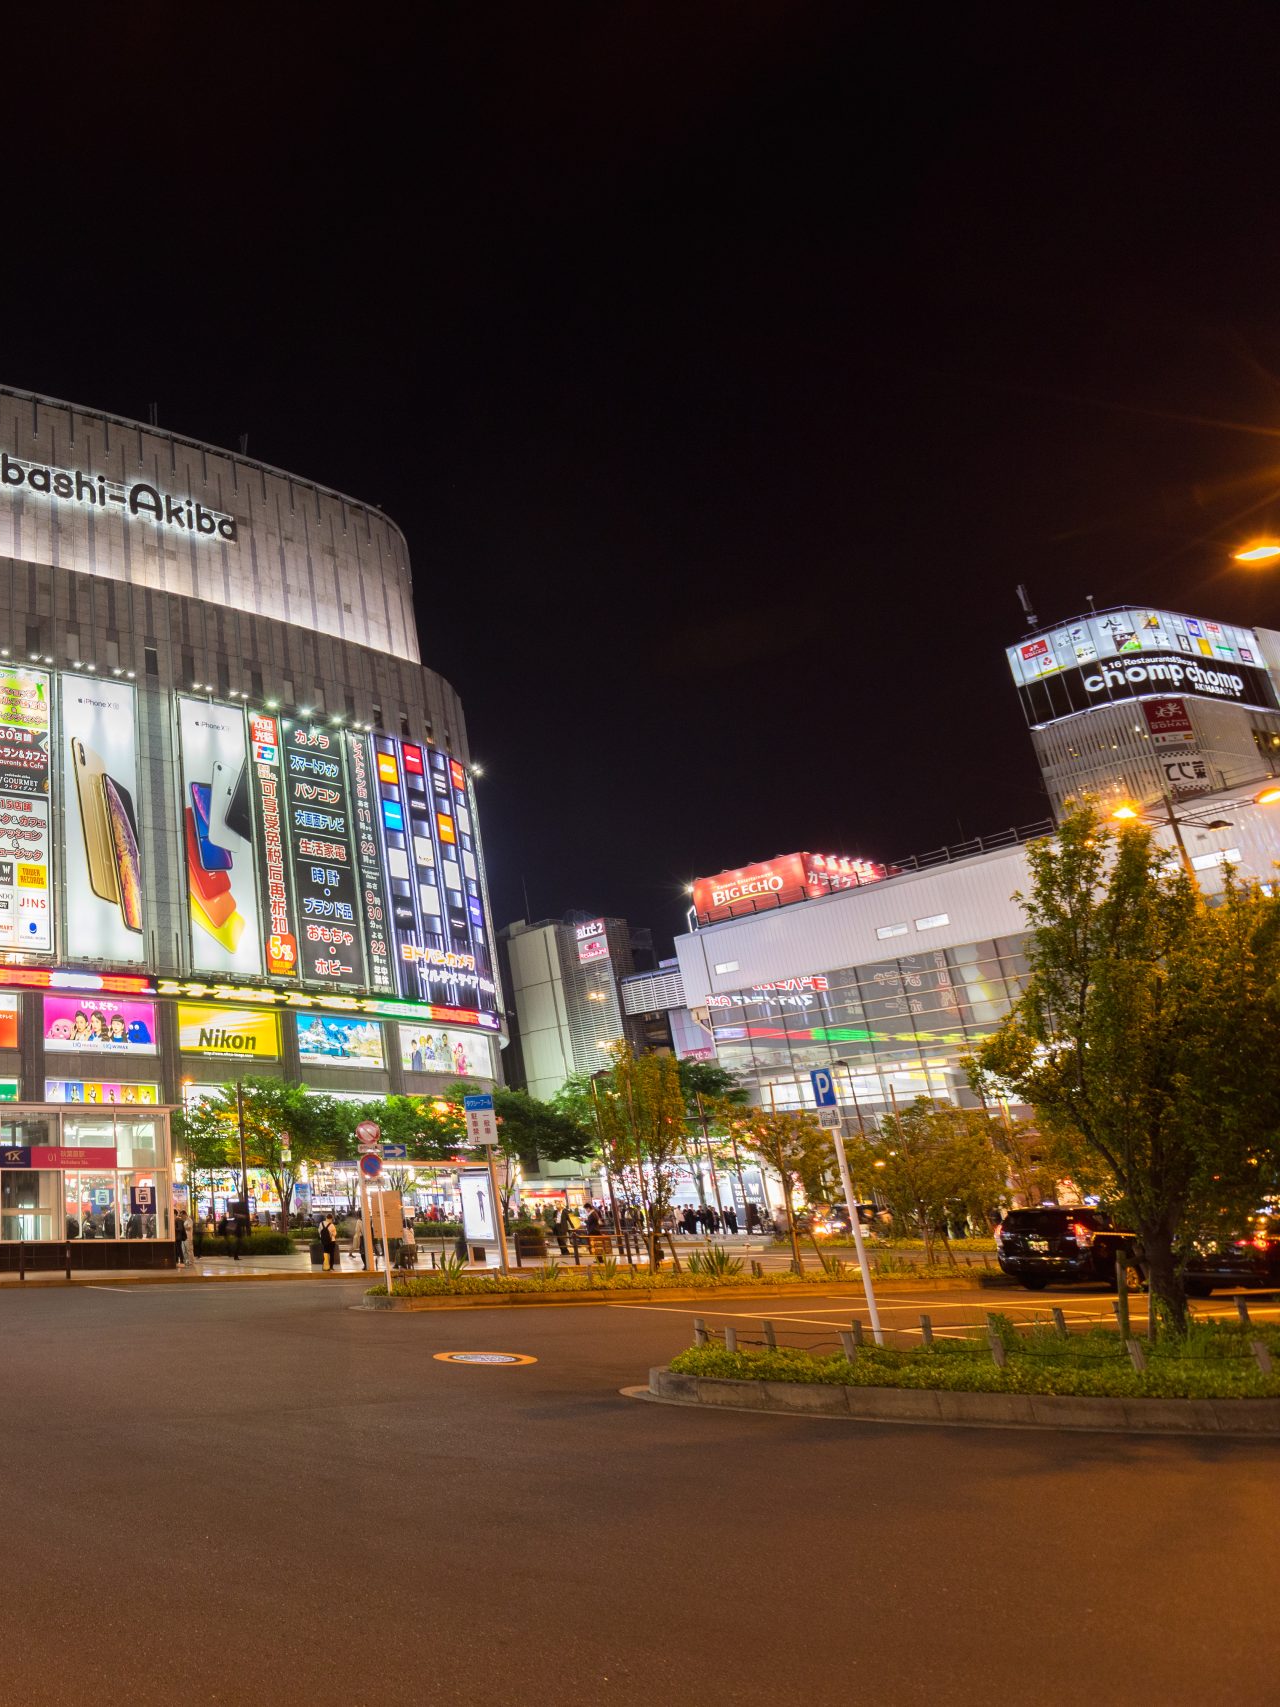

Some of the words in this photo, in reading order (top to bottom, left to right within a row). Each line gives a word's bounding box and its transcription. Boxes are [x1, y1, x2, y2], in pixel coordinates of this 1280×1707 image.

[1109, 661, 1122, 669] 16
[1084, 664, 1185, 692] chomp
[1185, 664, 1244, 693] chomp
[84, 698, 106, 708] iPhone
[294, 729, 329, 749] カメラ
[290, 754, 339, 777] スマートフォン
[4, 777, 38, 787] GOURMET
[294, 783, 340, 803] パソコン
[294, 810, 344, 832] 大画面テレビ
[358, 808, 370, 823] 11
[299, 838, 347, 861] 生活家電
[361, 840, 376, 856] 23
[311, 866, 340, 886] 時計
[808, 870, 852, 888] カラオケ
[712, 889, 740, 906] BIG
[741, 876, 783, 894] ECHO
[303, 898, 353, 920] ブランド品
[367, 905, 382, 920] 30
[307, 925, 353, 945] おもちゃ
[370, 940, 386, 955] 22
[401, 943, 475, 971] ヨドバシカメラ
[315, 958, 353, 976] ホビー
[199, 1028, 256, 1050] Nikon
[816, 1073, 829, 1103] P
[5, 1150, 23, 1161] TX
[48, 1153, 57, 1162] 01
